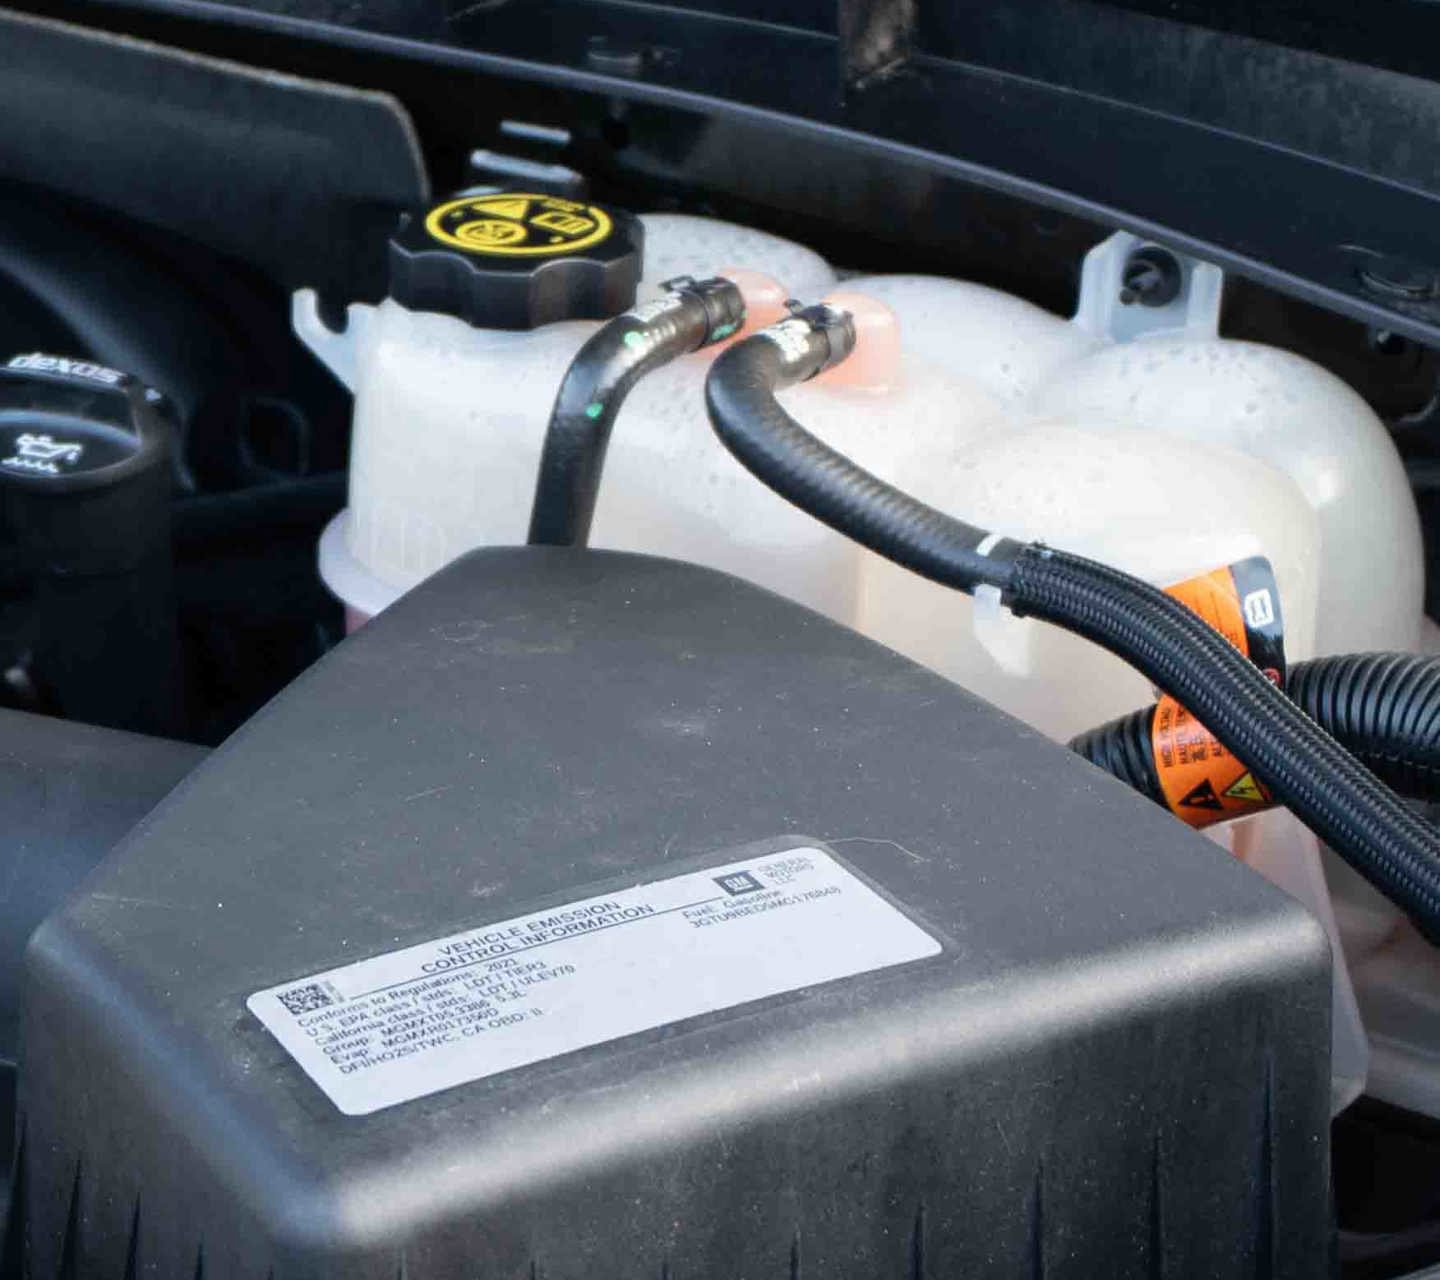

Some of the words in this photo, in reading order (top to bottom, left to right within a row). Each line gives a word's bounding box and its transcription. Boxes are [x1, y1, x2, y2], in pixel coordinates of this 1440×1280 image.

[421, 942, 515, 973] CONTROL
[520, 903, 655, 945] INFORMATION
[438, 927, 524, 956] VEHICLE
[525, 900, 621, 932] EMISSION
[297, 1003, 369, 1027] Conforms
[370, 996, 387, 1006] to
[486, 959, 519, 972] 2021
[315, 1021, 385, 1046] California
[388, 1007, 425, 1024] class
[479, 983, 508, 998] LDT
[521, 964, 576, 986] ULEV70
[340, 1013, 369, 1027] EPA
[373, 1001, 411, 1018] class
[464, 976, 495, 990] LDT
[462, 1024, 484, 1037] CA
